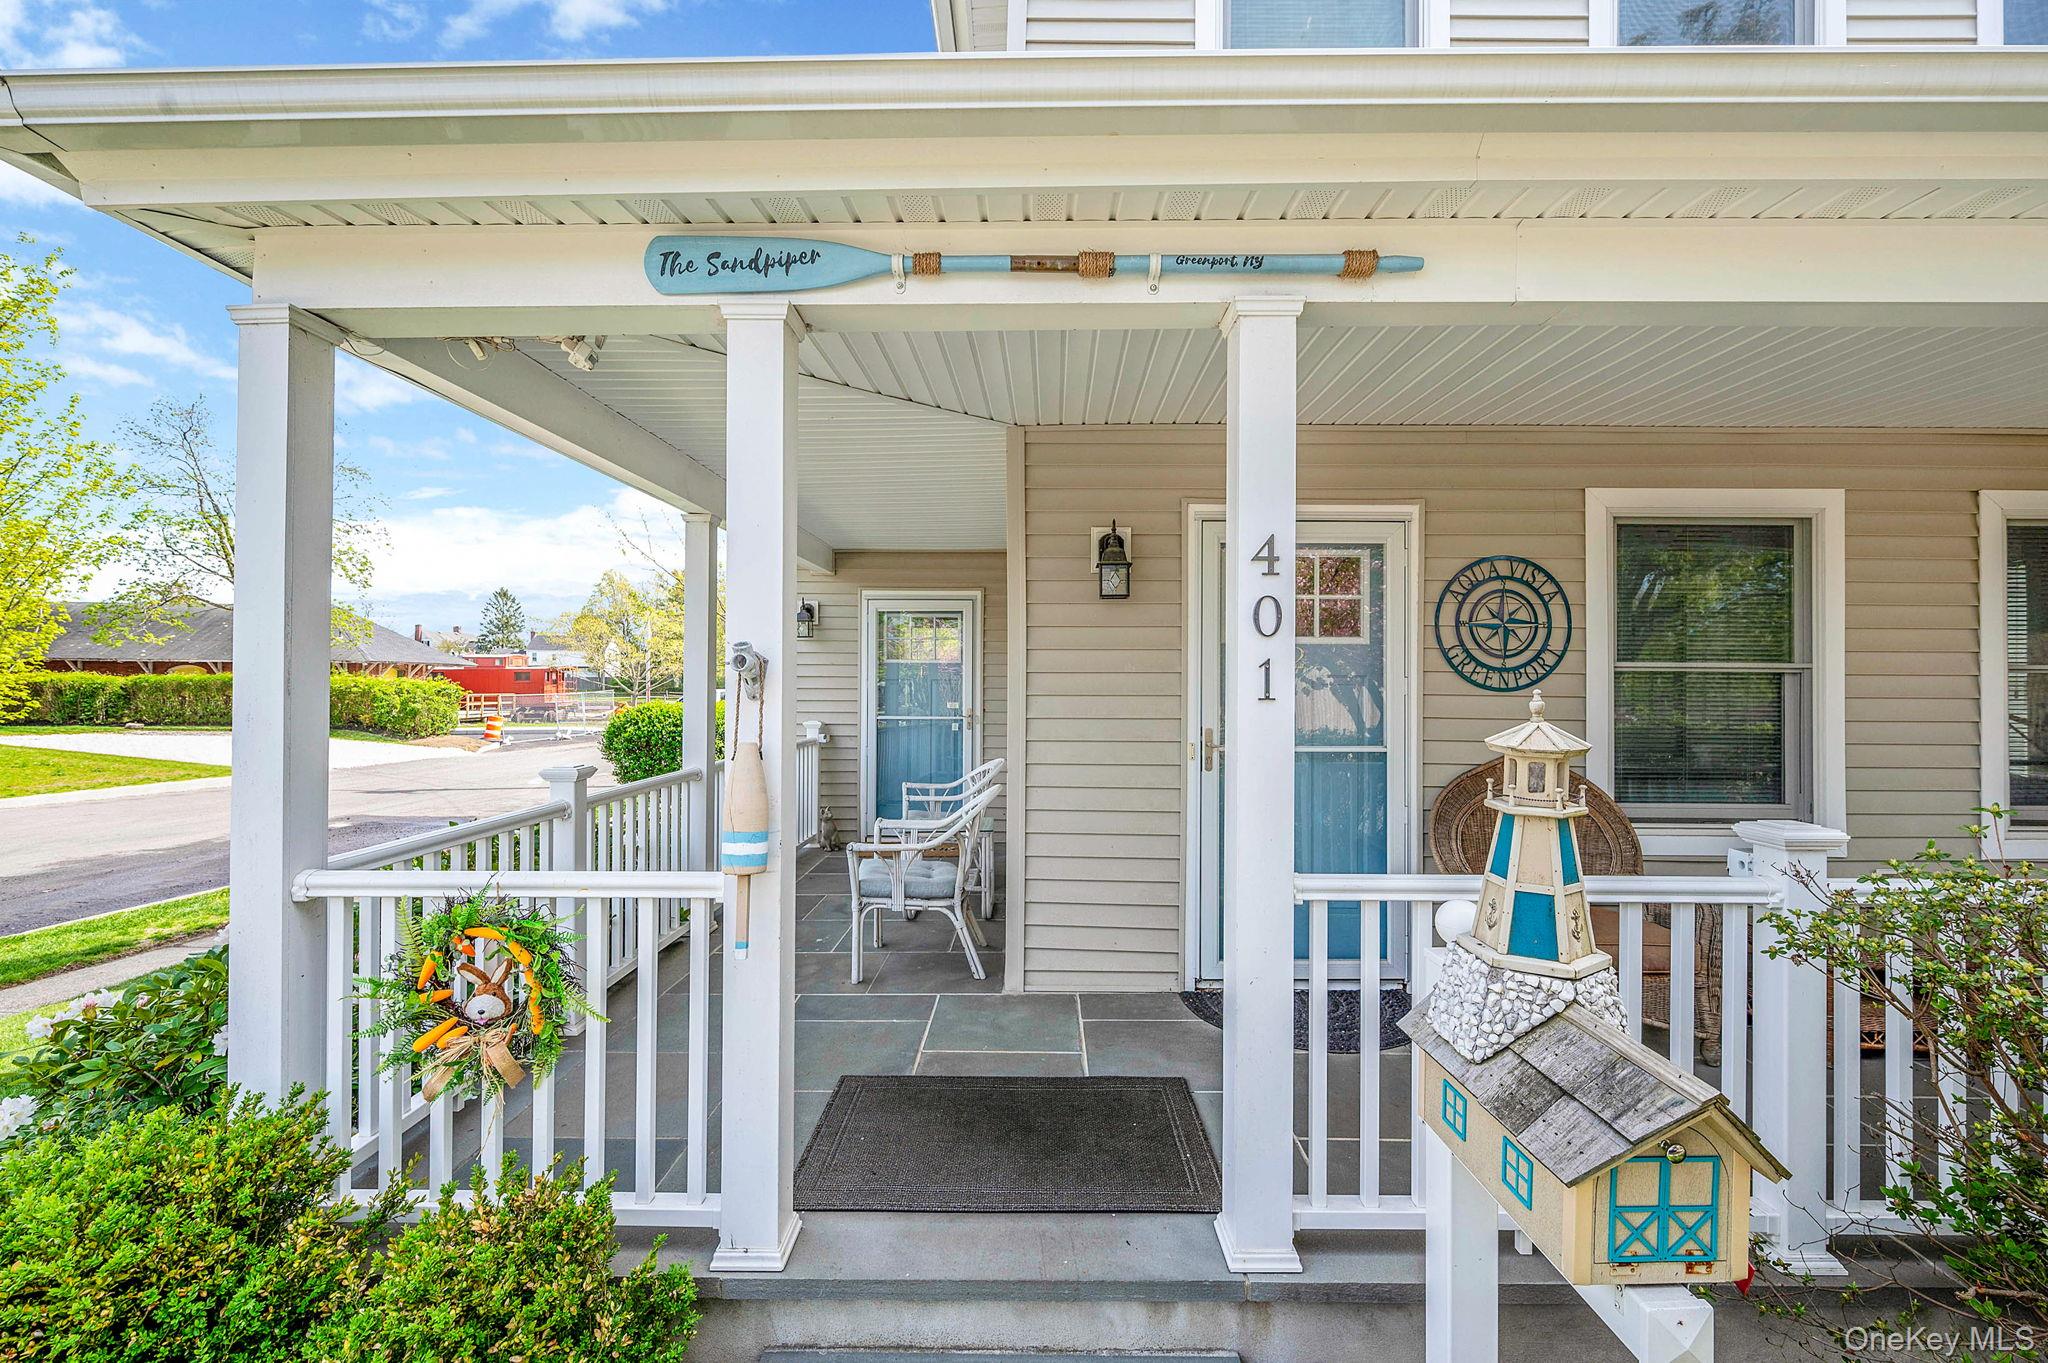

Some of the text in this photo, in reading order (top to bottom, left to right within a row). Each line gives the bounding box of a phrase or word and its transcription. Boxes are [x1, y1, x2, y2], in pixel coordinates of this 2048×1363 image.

[659, 247, 821, 278] The Sandpiper
[1449, 561, 1560, 603] AQUA VISTA
[1447, 644, 1560, 688] GREENPORT
